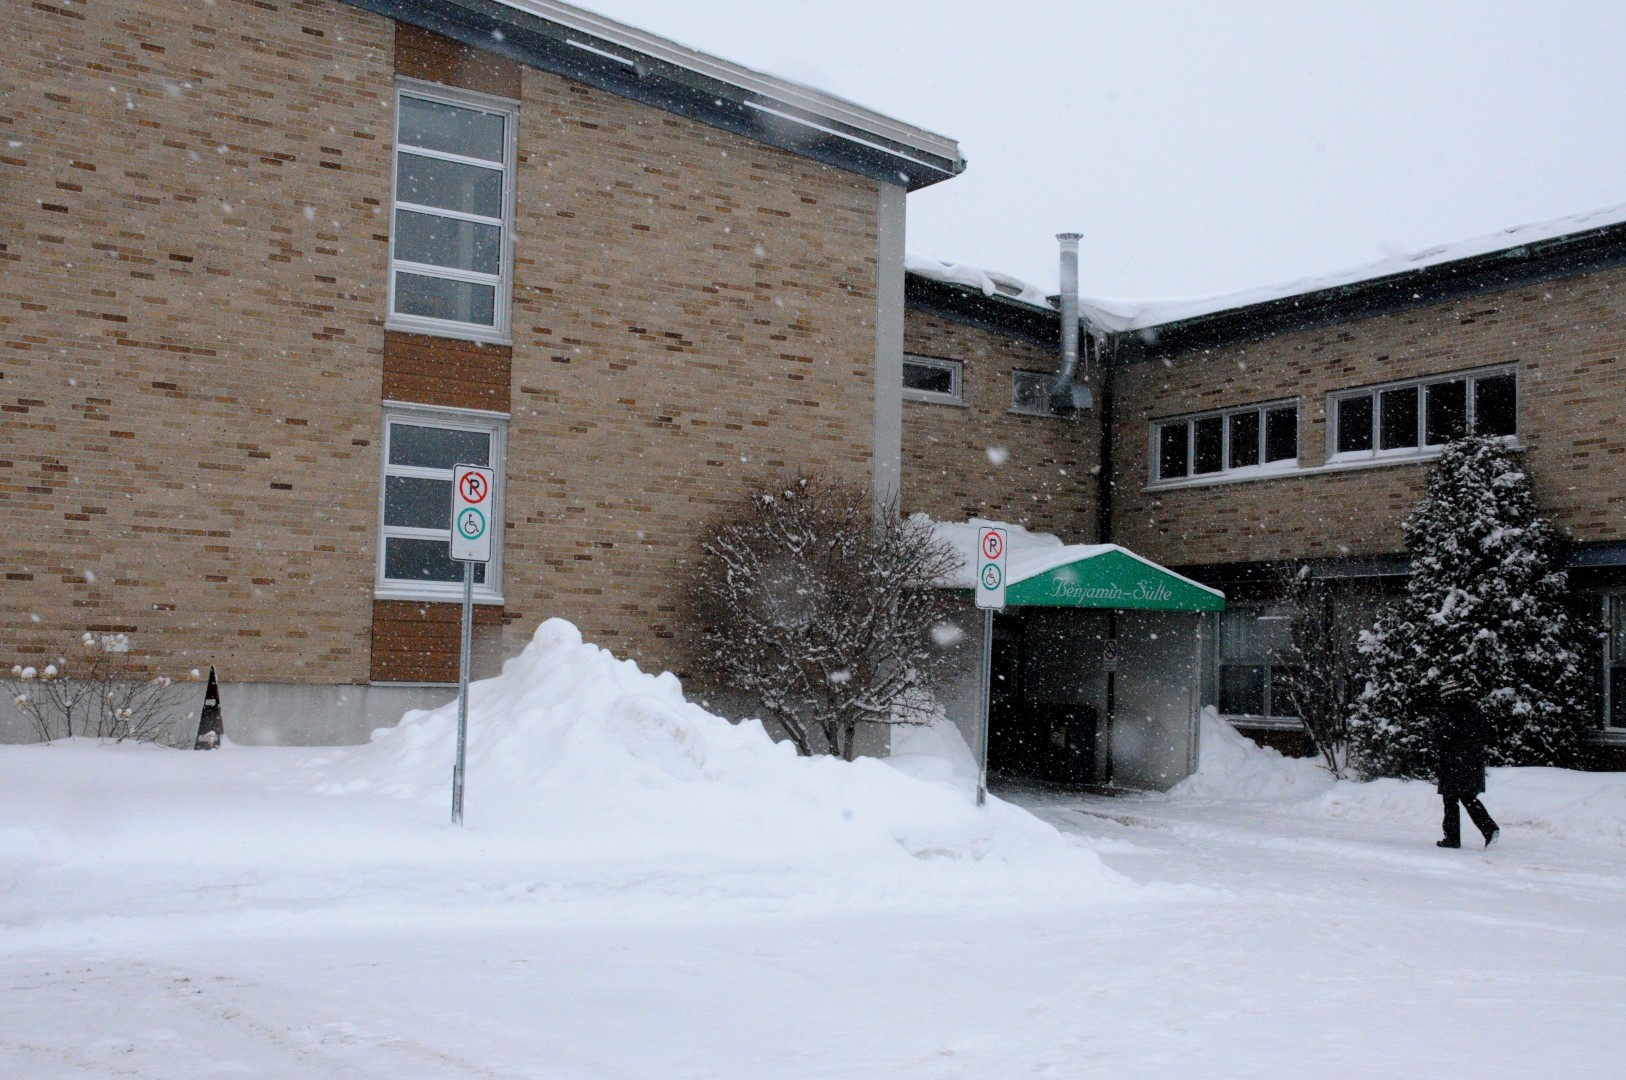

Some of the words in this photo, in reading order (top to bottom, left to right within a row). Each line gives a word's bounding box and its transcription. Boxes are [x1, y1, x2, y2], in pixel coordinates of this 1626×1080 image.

[469, 479, 479, 495] P
[989, 538, 997, 552] P
[1052, 576, 1172, 603] Benjamin-Sulte
